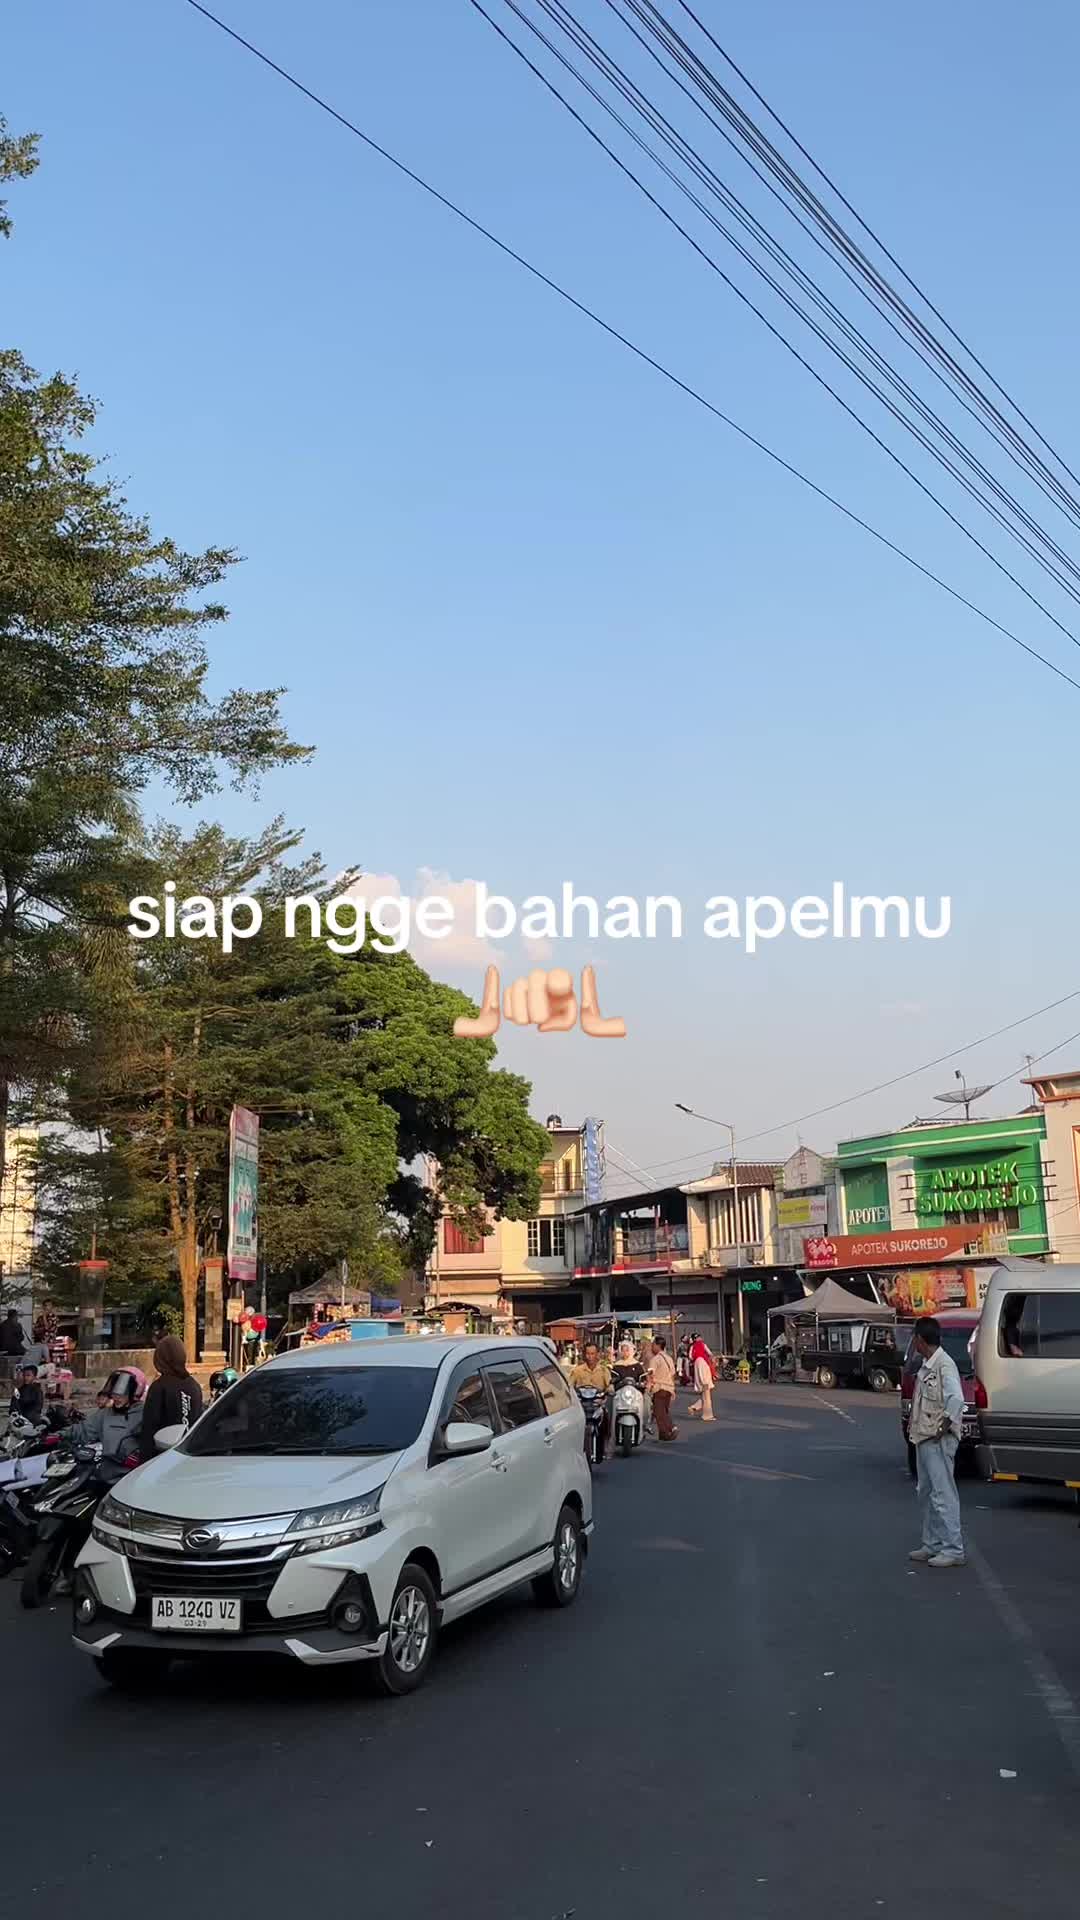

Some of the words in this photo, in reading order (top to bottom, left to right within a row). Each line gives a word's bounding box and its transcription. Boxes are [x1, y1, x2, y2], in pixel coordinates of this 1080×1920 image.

[930, 1161, 1019, 1189] APOTEK
[919, 1184, 1037, 1213] SUKOREJO
[851, 1242, 888, 1256] APOTEK
[890, 1237, 948, 1253] SUKOREJO
[157, 1600, 174, 1617] AB
[179, 1601, 213, 1618] 1240
[220, 1601, 236, 1619] VZ
